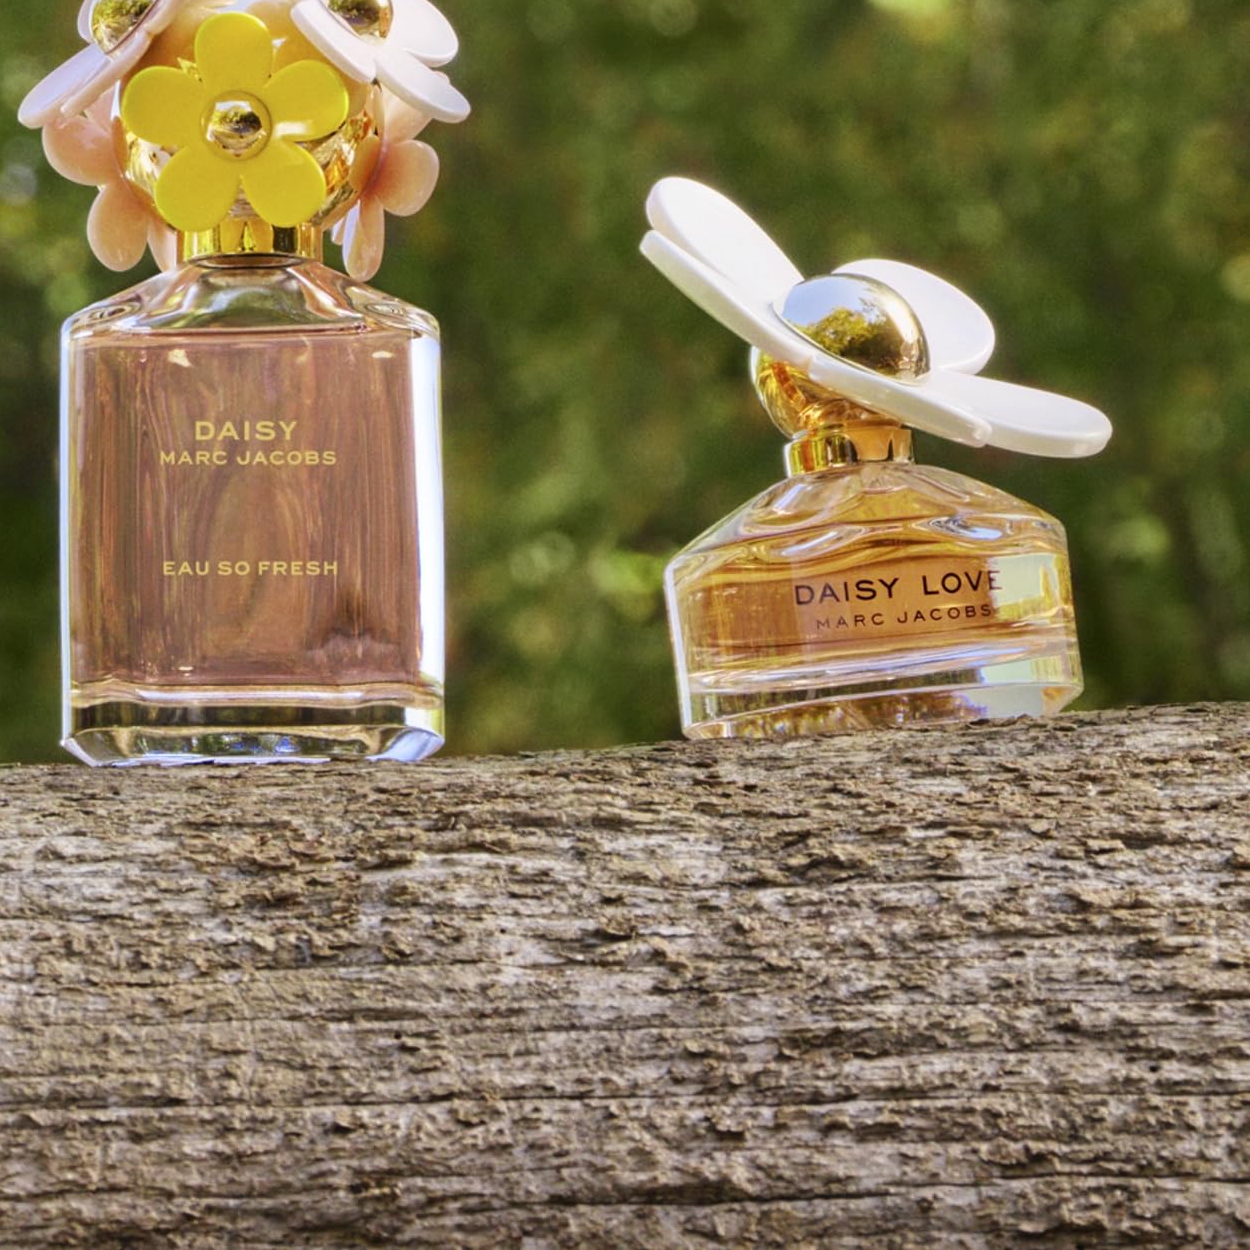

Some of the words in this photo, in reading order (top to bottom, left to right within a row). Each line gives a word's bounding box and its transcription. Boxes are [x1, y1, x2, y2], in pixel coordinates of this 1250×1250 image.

[195, 420, 297, 441] DAISY
[160, 451, 227, 465] MARC
[236, 451, 337, 465] JACOBS
[162, 561, 210, 575] EAU
[217, 561, 250, 575] SO
[258, 561, 338, 575] FRESH
[794, 577, 899, 606] DAISY
[922, 570, 1003, 596] LOVE
[816, 612, 884, 630] MARC
[897, 604, 992, 623] JACOBS
